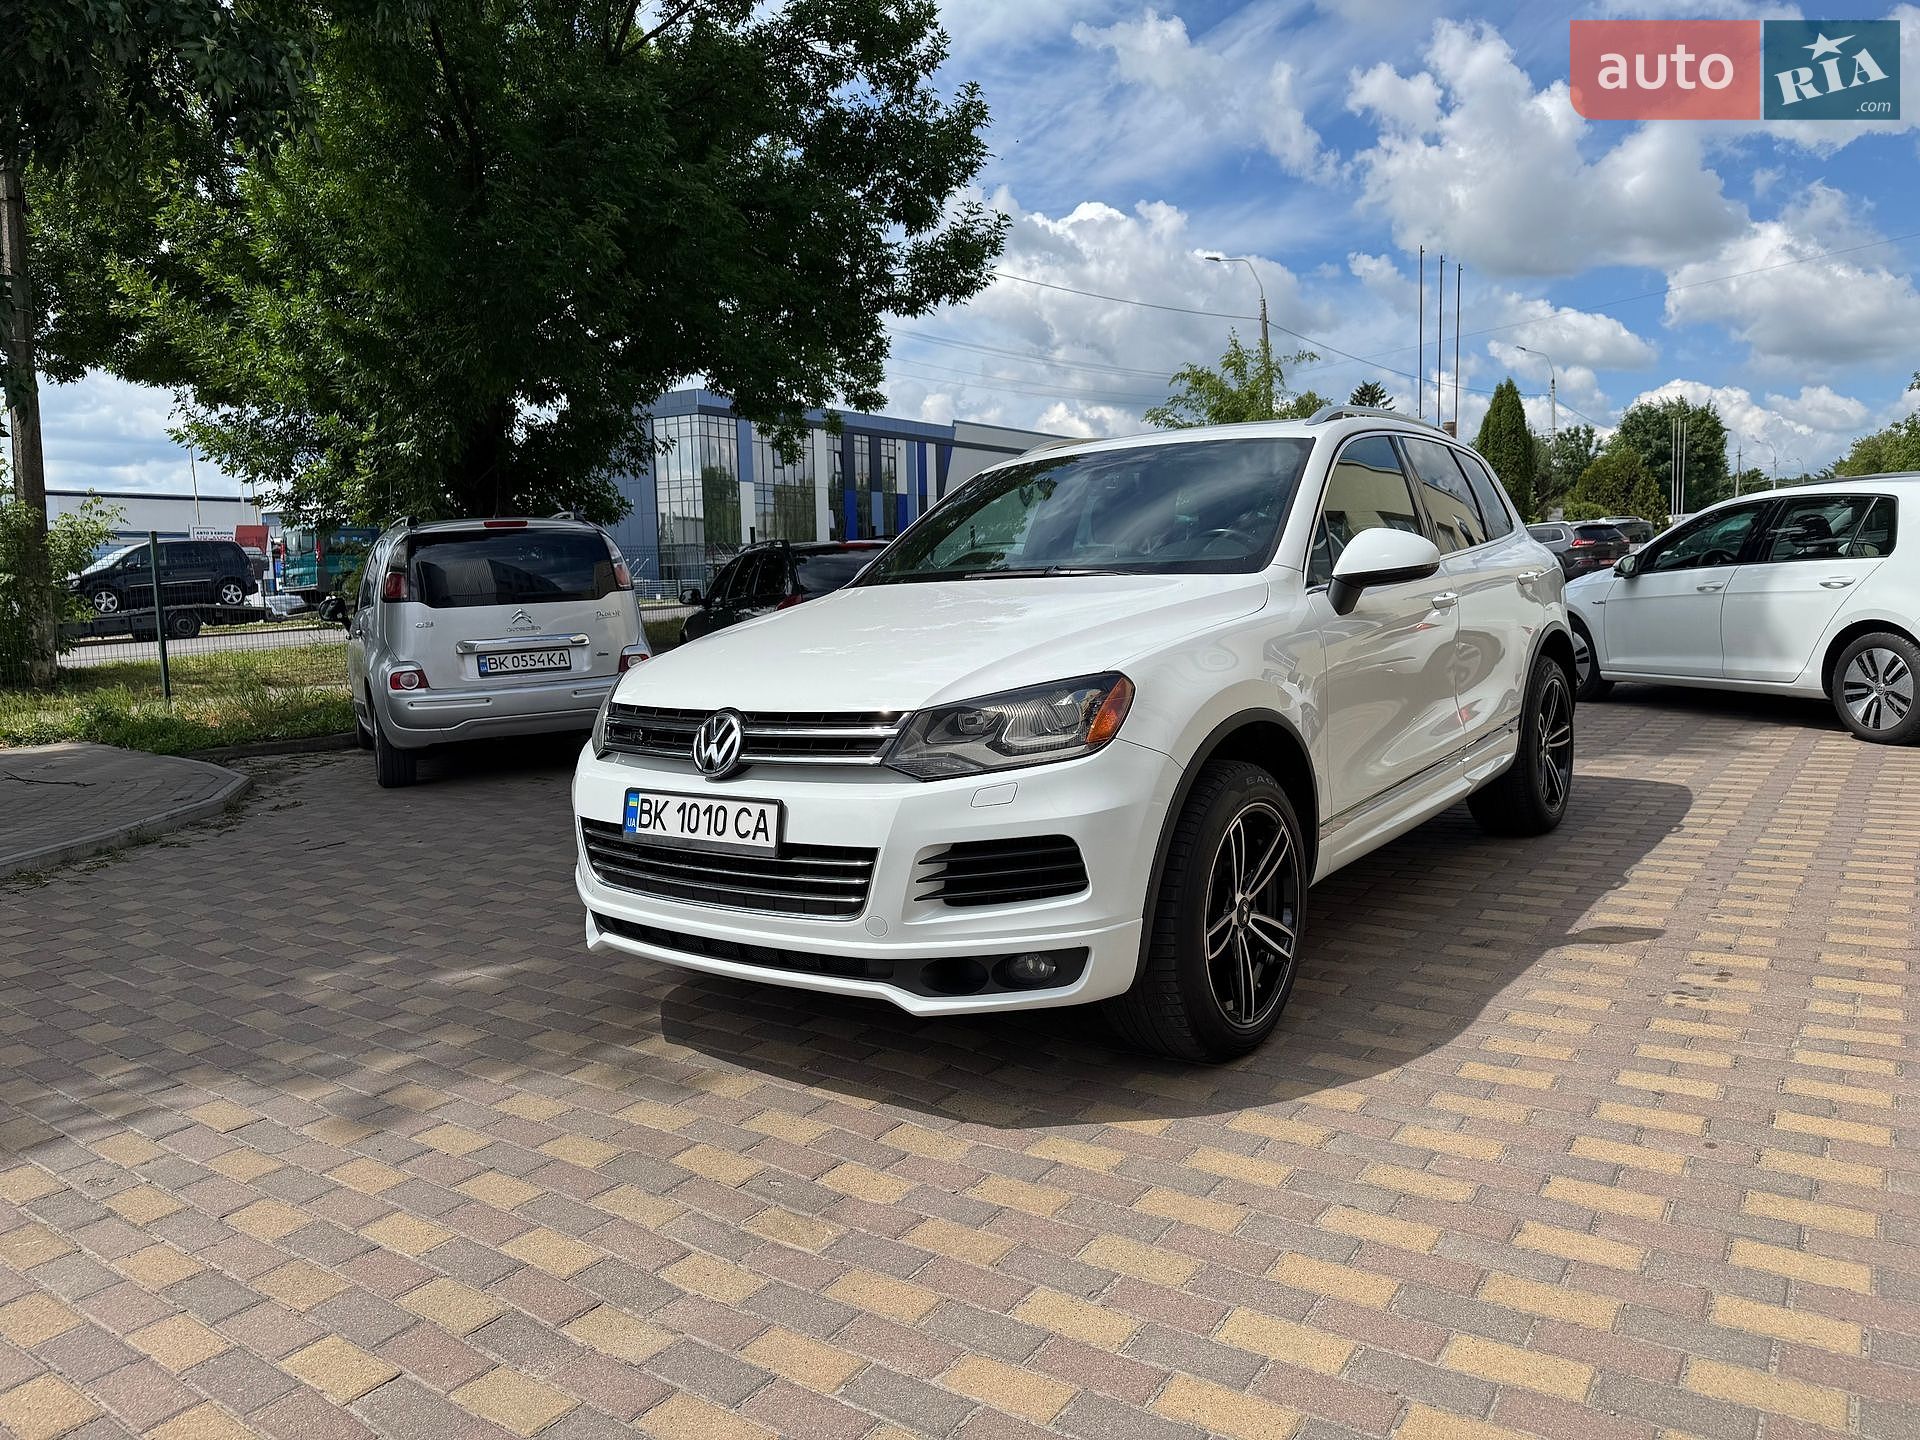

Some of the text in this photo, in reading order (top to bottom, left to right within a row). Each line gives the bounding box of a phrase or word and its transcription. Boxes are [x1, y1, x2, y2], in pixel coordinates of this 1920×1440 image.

[487, 652, 568, 671] BK 0554 KA
[627, 817, 636, 828] UA
[638, 798, 770, 842] BK 1010 CA
